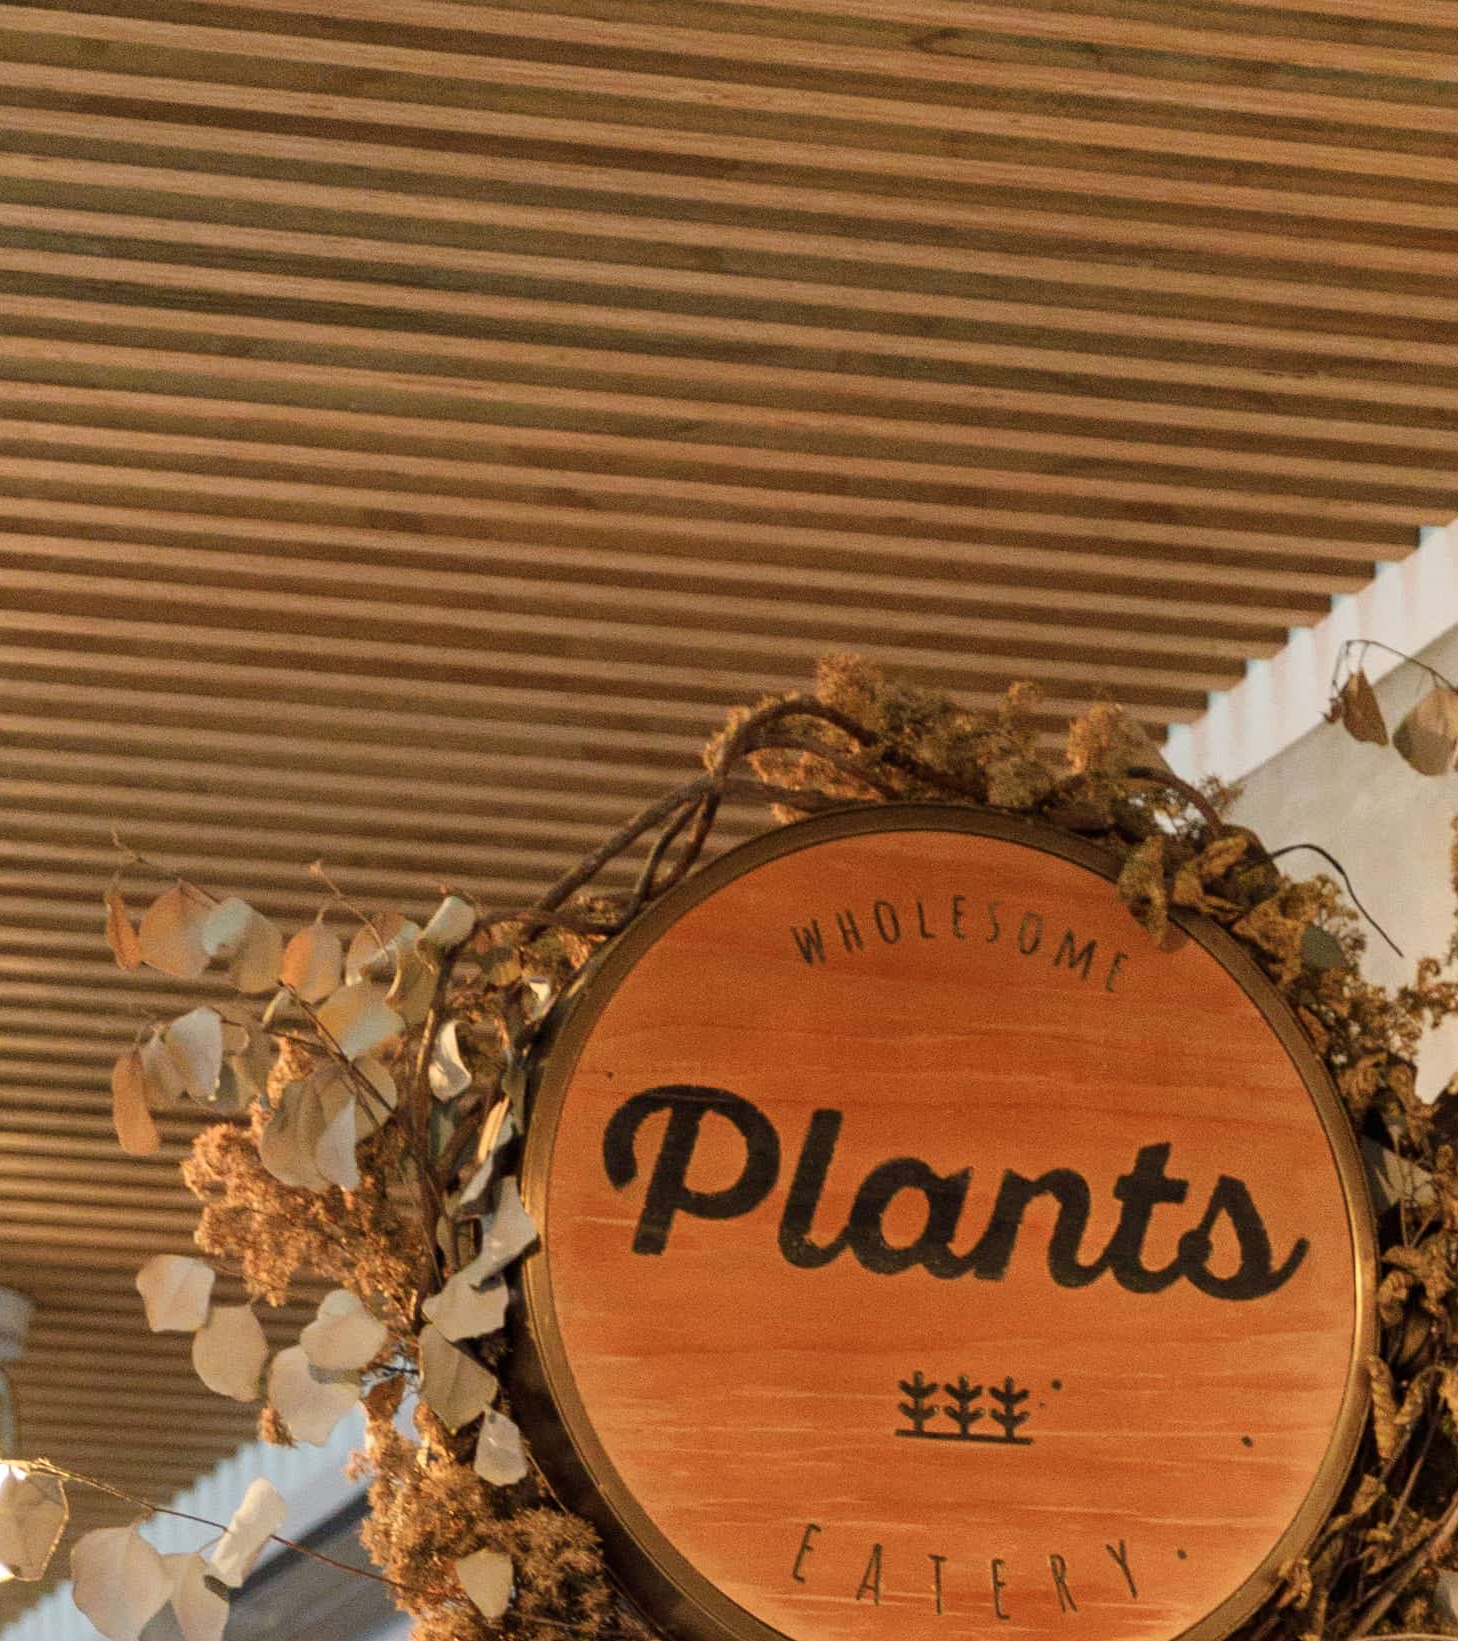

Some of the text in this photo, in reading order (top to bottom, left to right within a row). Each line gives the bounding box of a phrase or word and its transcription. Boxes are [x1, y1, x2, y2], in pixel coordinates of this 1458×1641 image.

[789, 893, 1133, 995] WHOLESOME
[601, 1083, 1310, 1302] Plants
[791, 1522, 1138, 1621] EATERY
